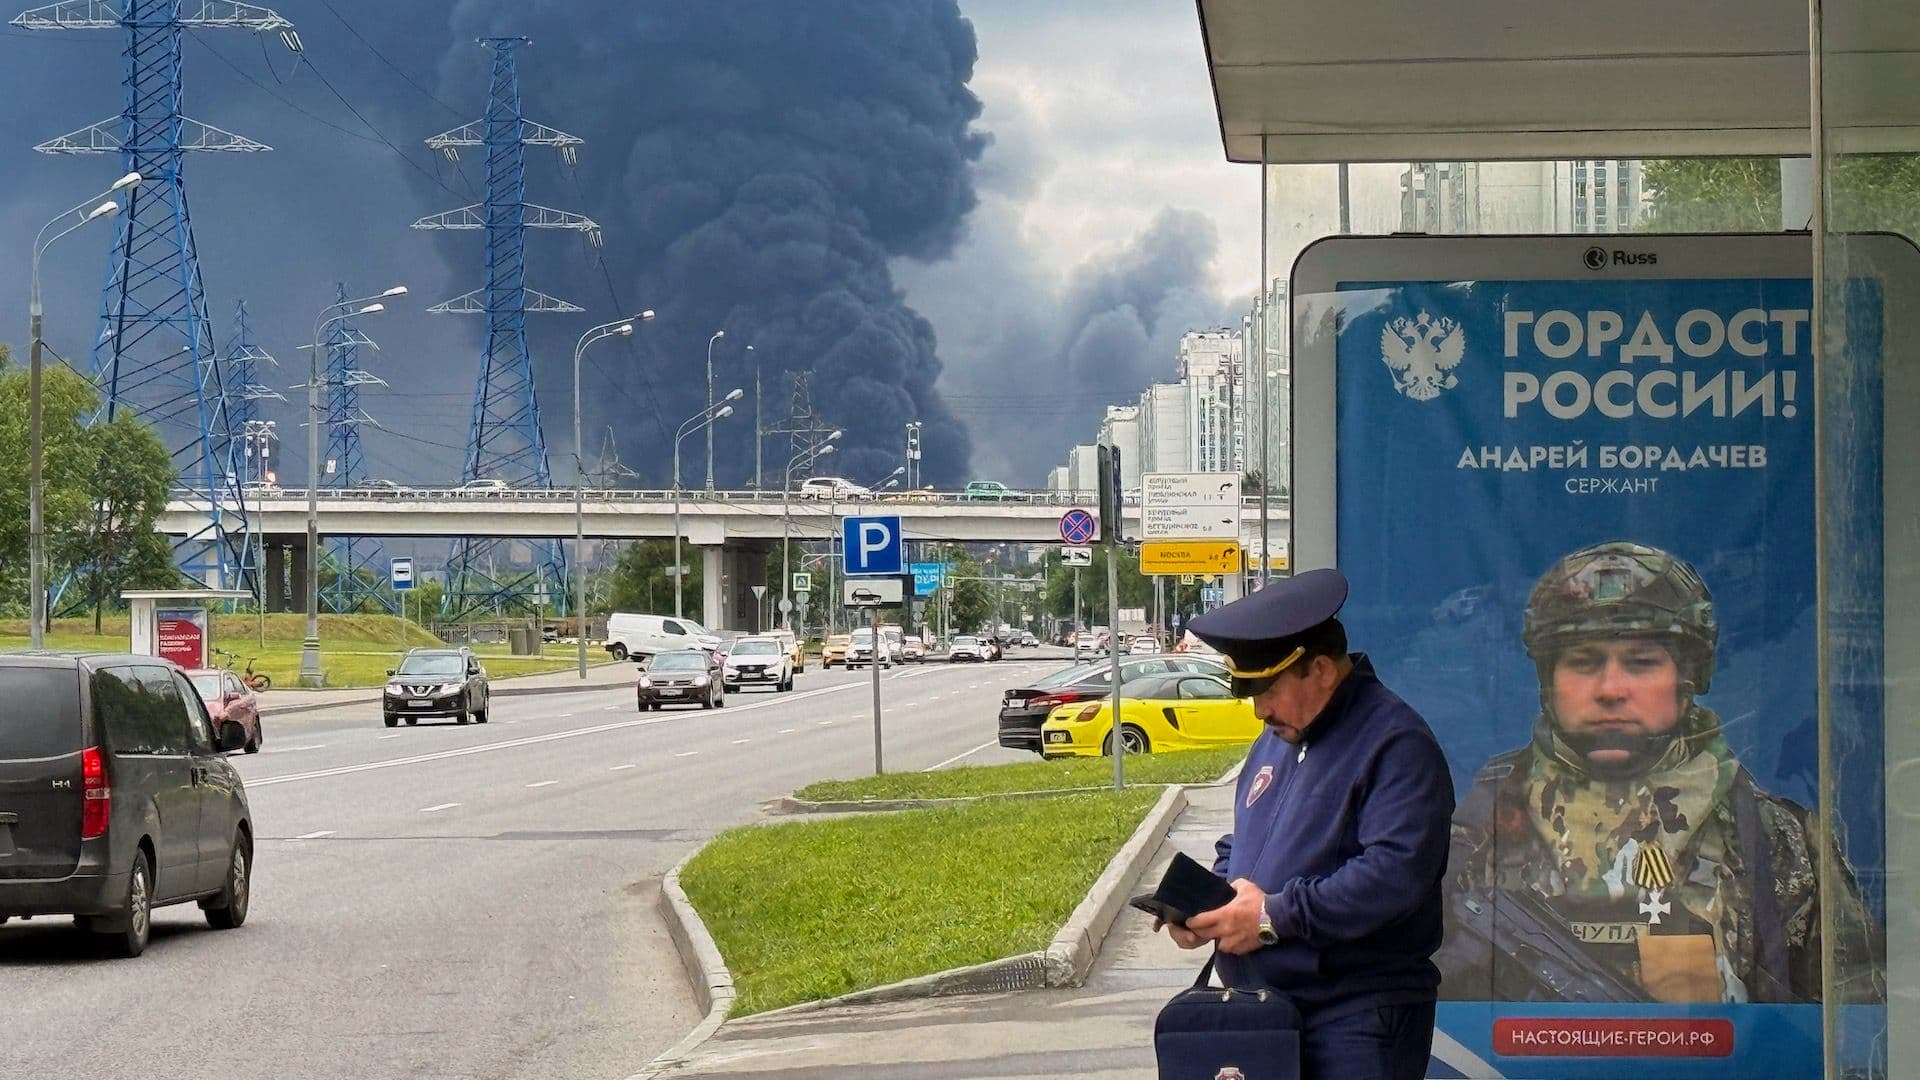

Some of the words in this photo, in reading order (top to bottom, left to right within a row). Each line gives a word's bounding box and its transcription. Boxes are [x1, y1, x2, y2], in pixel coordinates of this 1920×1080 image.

[1613, 250, 1657, 266] Russ
[1504, 309, 1814, 364] ГОРДОСТ
[1503, 369, 1797, 419] РОССИИ!
[1457, 440, 1588, 472] АНДРЕЙ
[1600, 445, 1767, 472] БОРДАЧЕВ
[1565, 477, 1659, 495] СЕРЖАНТ
[859, 522, 891, 568] P
[1511, 1029, 1715, 1047] НАСТОЯЩИЕ-ГЕРОИ.РФ
